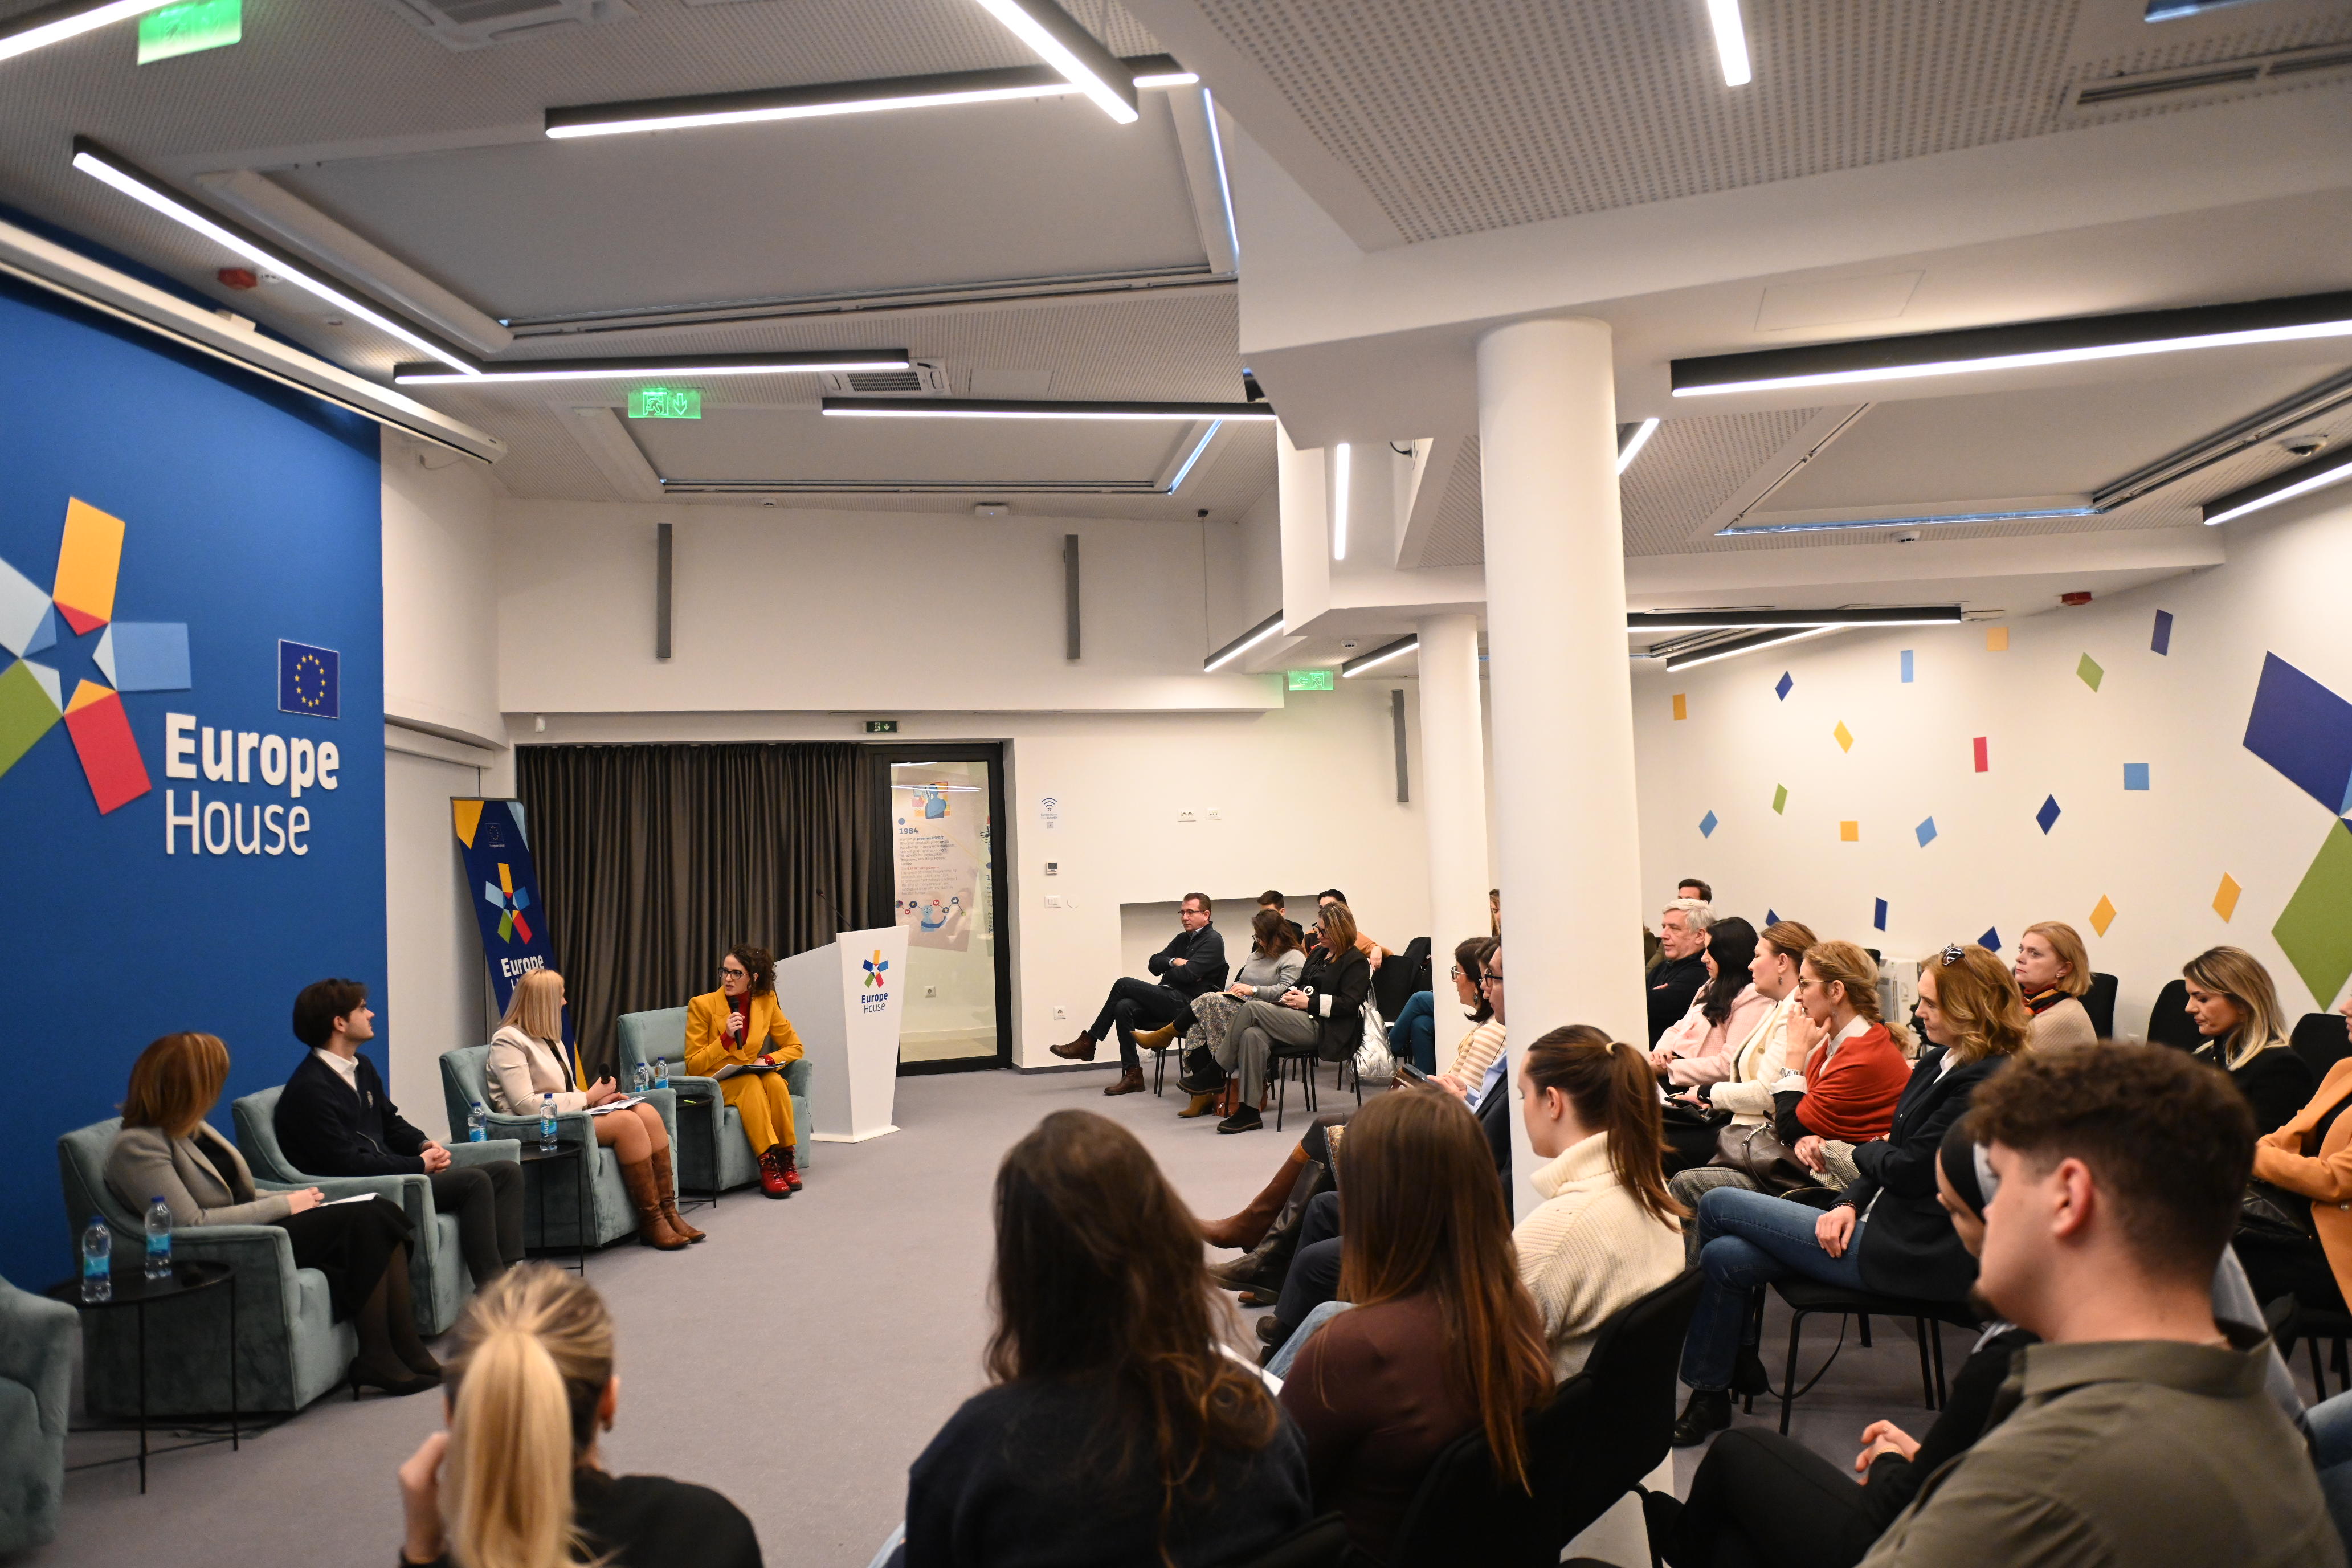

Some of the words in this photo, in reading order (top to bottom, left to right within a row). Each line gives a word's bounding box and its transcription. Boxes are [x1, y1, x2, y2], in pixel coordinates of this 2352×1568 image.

[166, 712, 339, 798] Europe
[166, 789, 310, 855] House
[501, 956, 544, 977] Europe
[861, 993, 888, 1004] Europe
[864, 1003, 885, 1014] House
